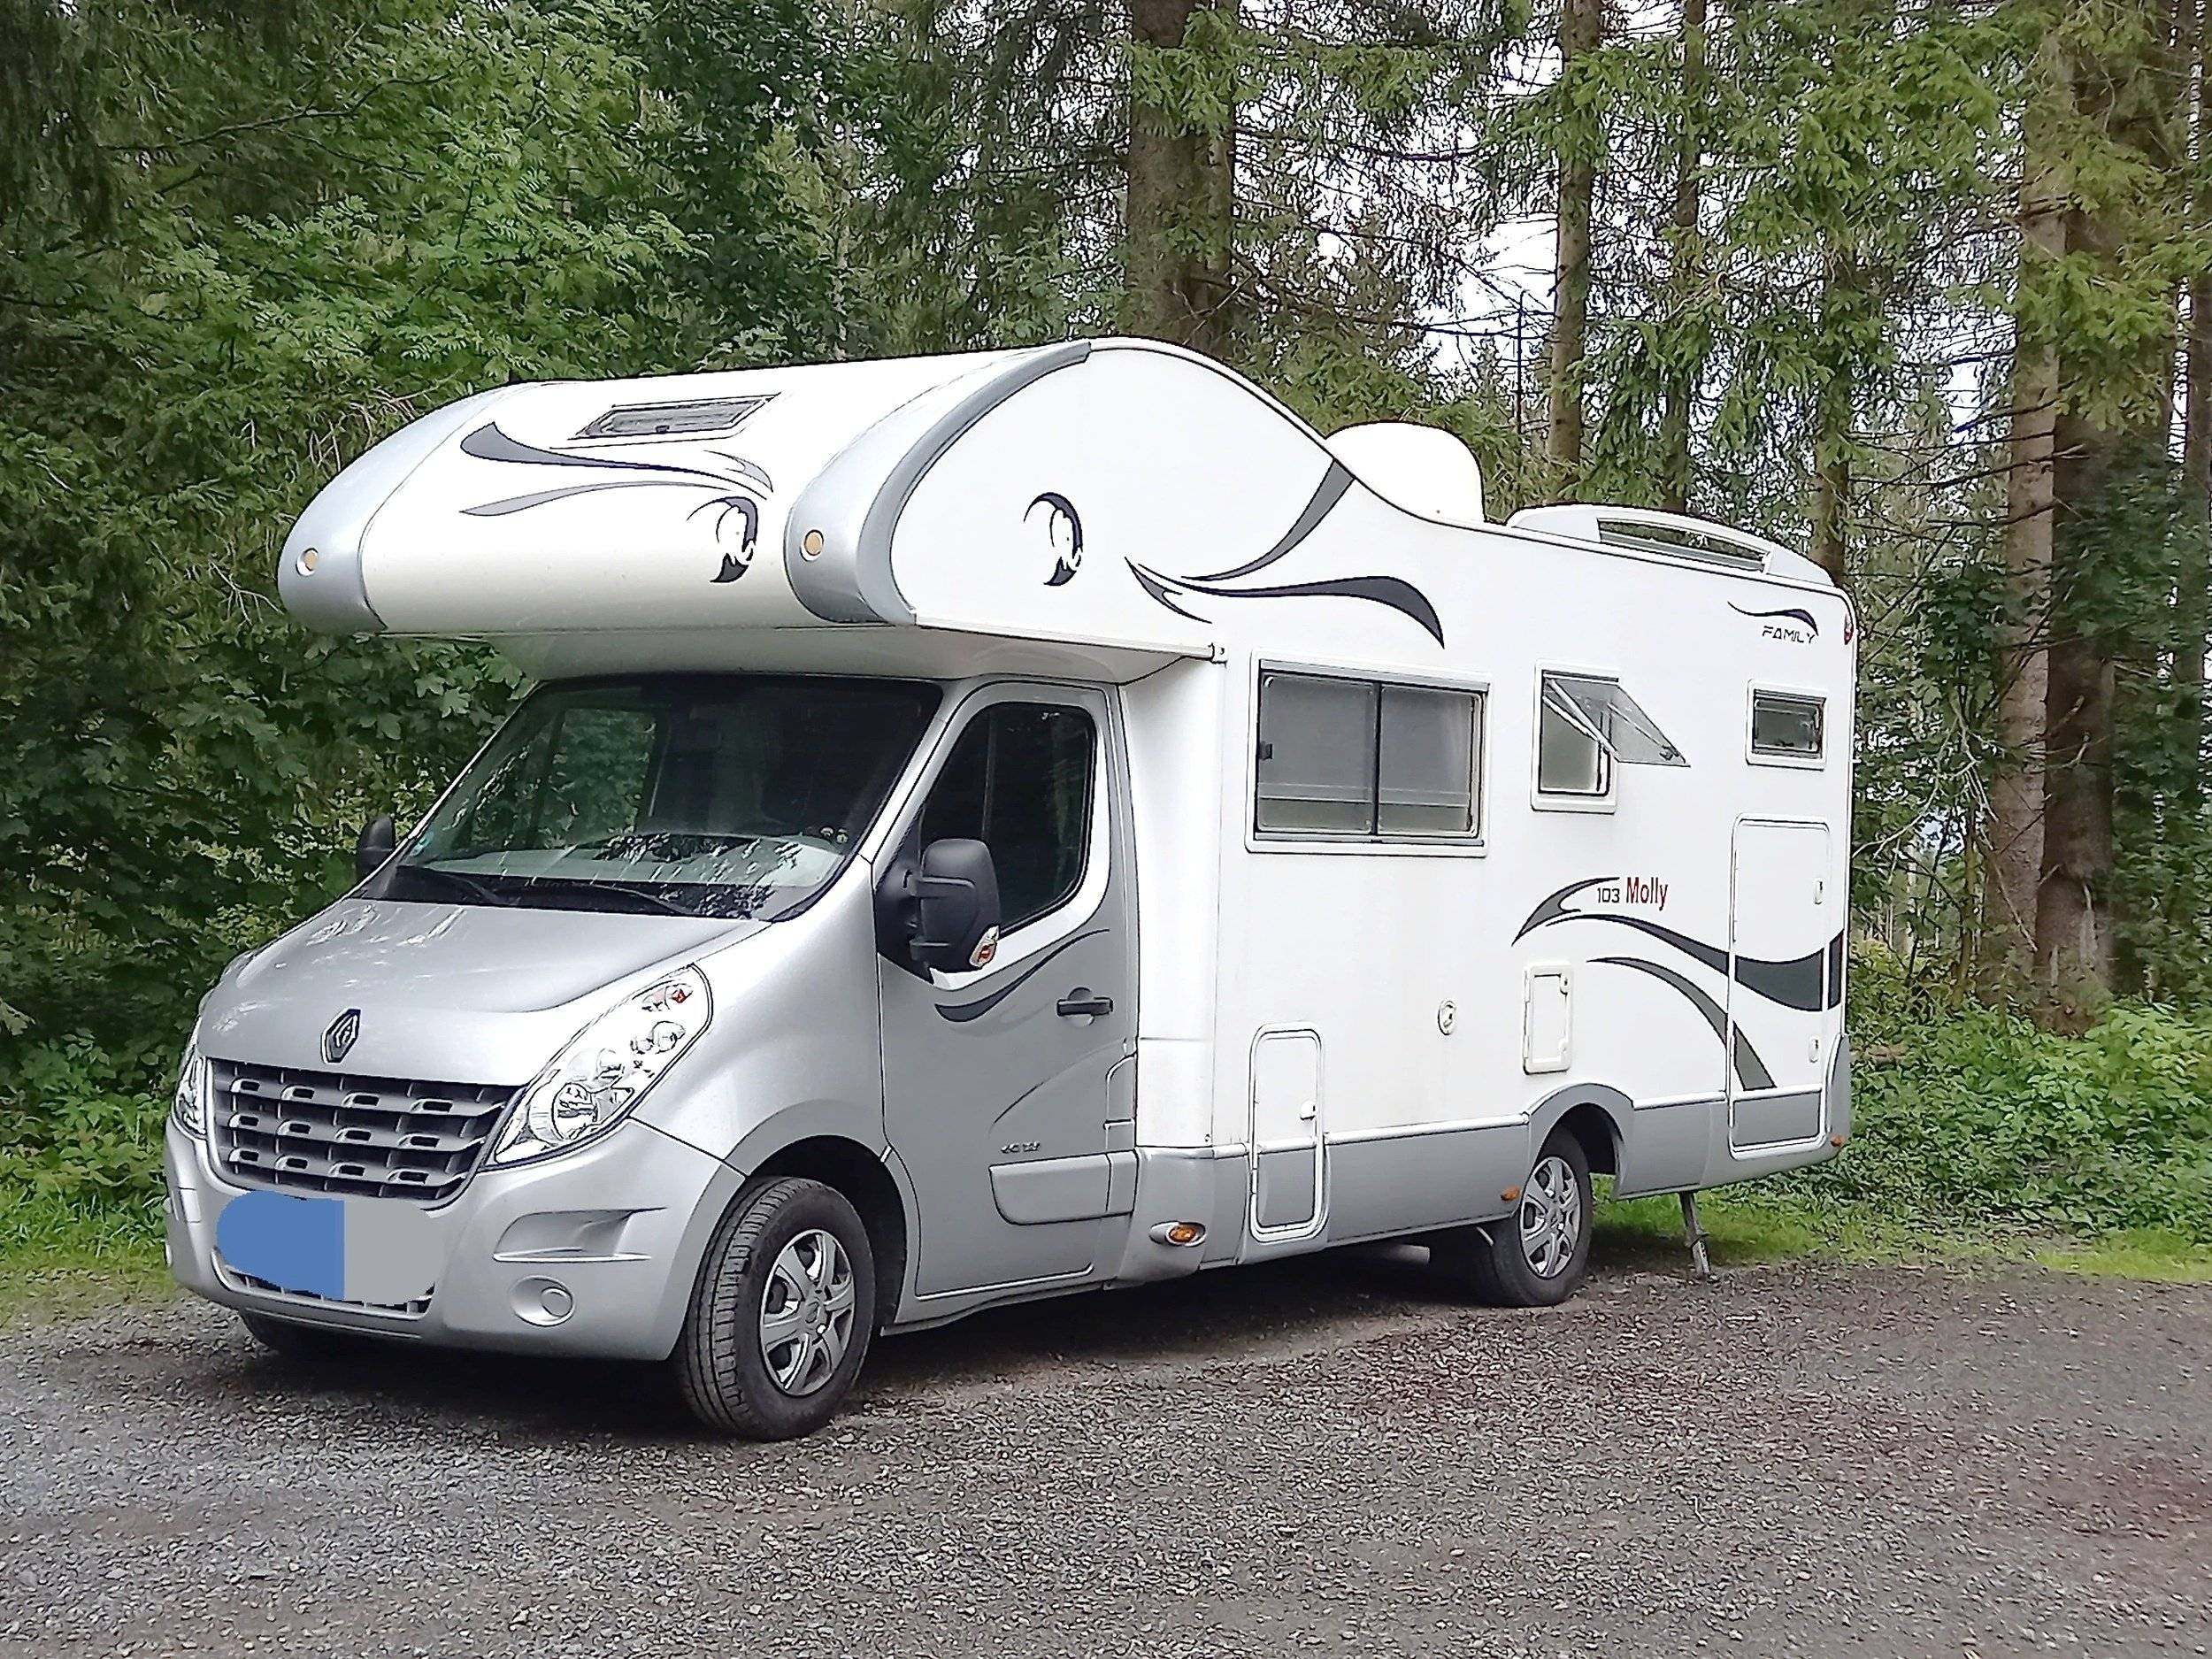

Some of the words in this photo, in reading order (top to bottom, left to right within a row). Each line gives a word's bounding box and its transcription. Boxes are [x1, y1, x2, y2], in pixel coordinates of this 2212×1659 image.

[1762, 625, 1815, 644] FAMILY
[1597, 887, 1620, 903] 103
[1625, 876, 1669, 911] Molly
